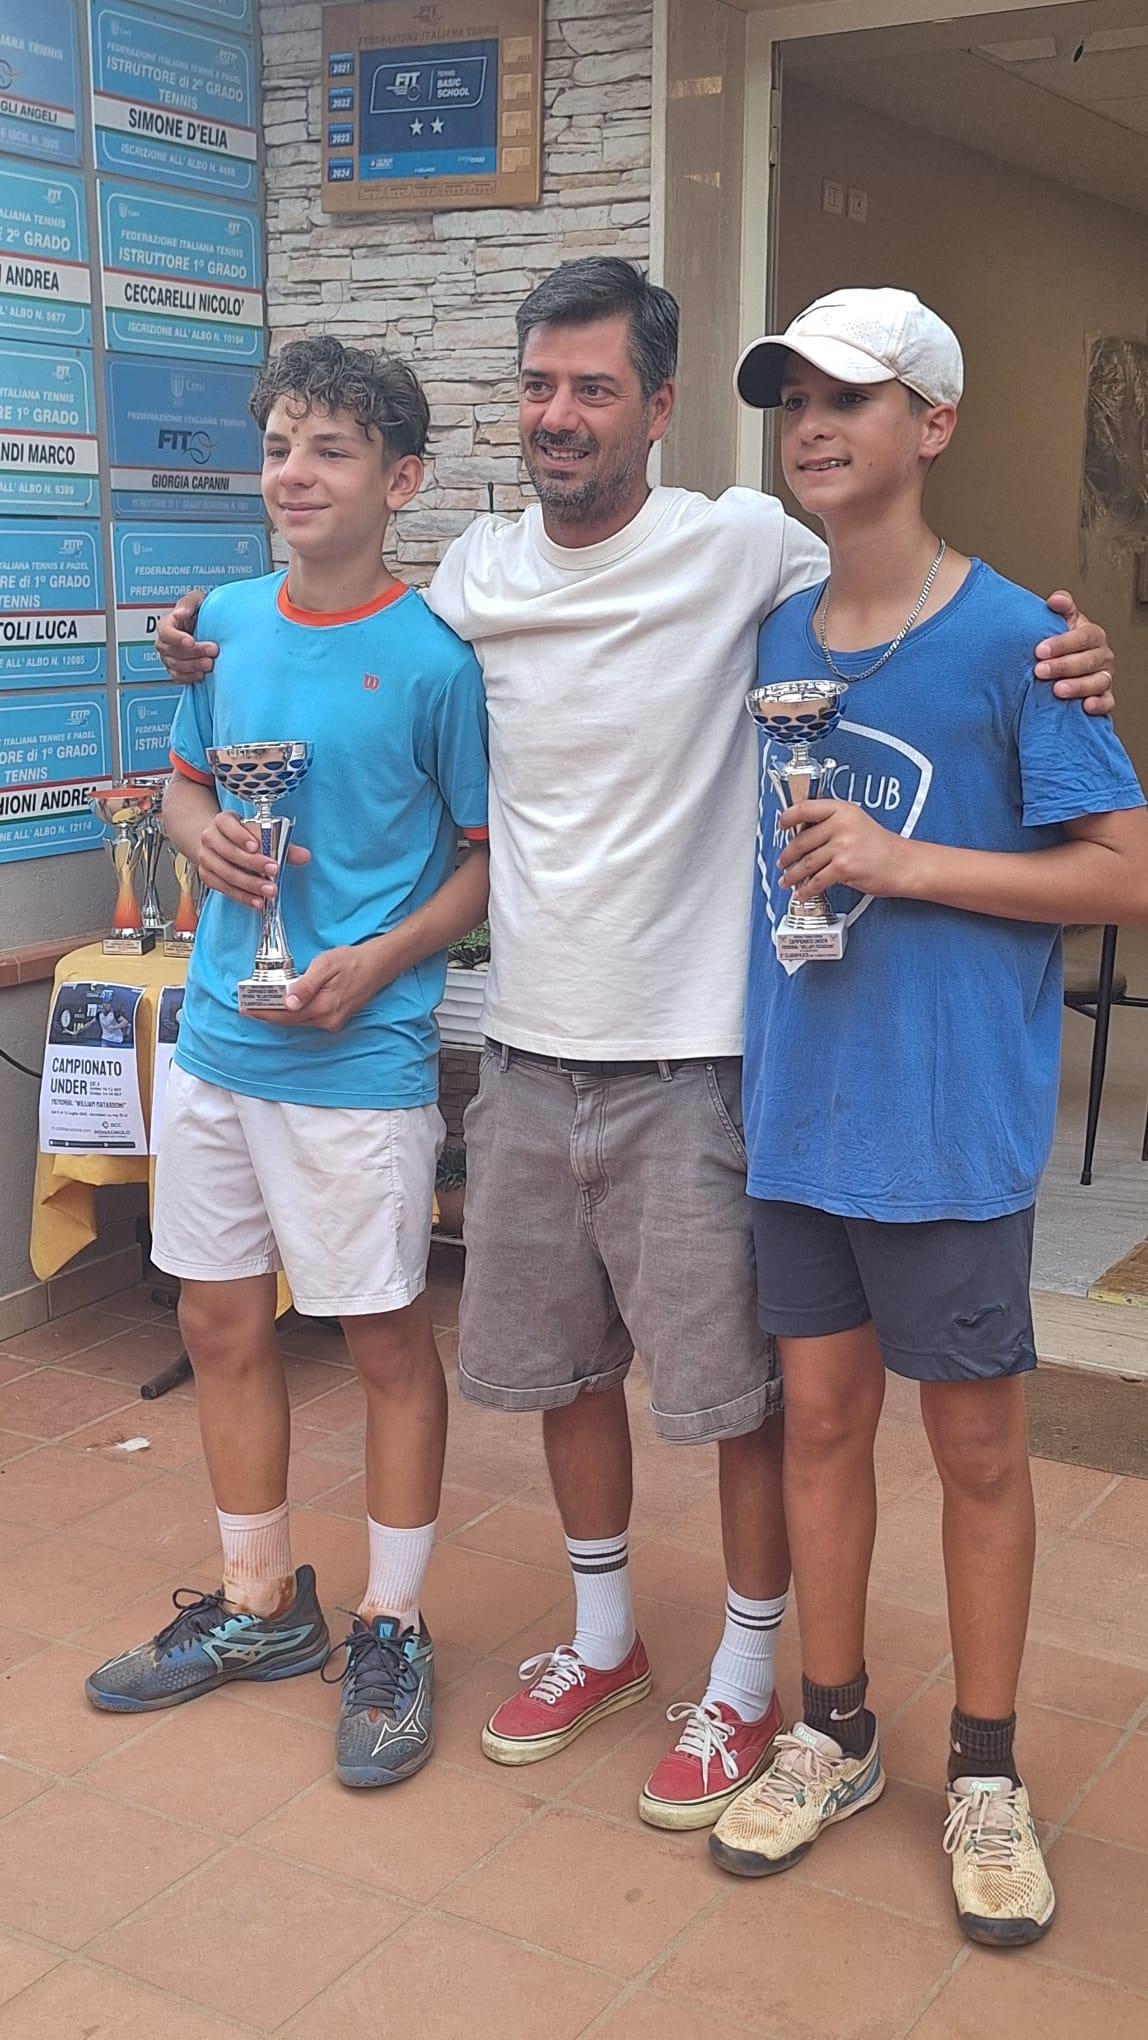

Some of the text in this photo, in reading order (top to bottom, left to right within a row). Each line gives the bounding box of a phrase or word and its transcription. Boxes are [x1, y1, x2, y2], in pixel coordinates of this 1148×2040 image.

[107, 56, 176, 86] ISTRUTTORE
[206, 82, 243, 103] GRADO
[437, 78, 462, 88] BASIC
[158, 89, 198, 110] TENNIS
[436, 87, 470, 99] SCHOOL
[20, 105, 57, 122] ANGELI
[128, 108, 228, 149] SIMONE D'ELIA
[121, 143, 167, 162] ISCRIZIONE
[33, 214, 66, 229] TENNIS
[24, 231, 71, 252] GRADO
[121, 230, 244, 259] FEDERAZIONE ITALIANA TENNIS
[119, 246, 190, 271] ISTRUTTORE
[207, 261, 247, 280] GRADO
[6, 264, 60, 292] ANDREA
[124, 282, 244, 316] CECCARELLI NICOLO'
[128, 321, 173, 337] ISCRIZIONE
[192, 329, 213, 341] ALBO
[43, 391, 74, 403] TENNIS
[33, 410, 79, 426] GRADO
[158, 429, 193, 451] FIT
[0, 441, 76, 467] NDI MARCO
[18, 483, 43, 494] ALBO
[151, 473, 230, 491] GIORGIA CAPANNI
[32, 561, 58, 570] TENNIS
[66, 561, 89, 570] PADEL
[135, 565, 253, 576] FEDERAZIONE ITALIANA TENNIS
[19, 575, 31, 589] di
[49, 574, 91, 589] GRADO
[130, 585, 191, 597] PREPARATORE
[35, 619, 78, 640] LUCA
[5, 656, 25, 669] ALL'
[26, 656, 49, 668] ALBO
[3, 735, 38, 747] ITALIANA
[39, 733, 66, 743] TENNIS
[73, 730, 96, 740] PADEL
[27, 748, 38, 762] di
[56, 743, 98, 759] GRADO
[4, 766, 49, 784] TENNIS
[13, 829, 33, 841] ALL'
[34, 825, 57, 838] ALBO
[51, 1057, 122, 1077] CAMPIONATO
[50, 1078, 88, 1096] UNDER
